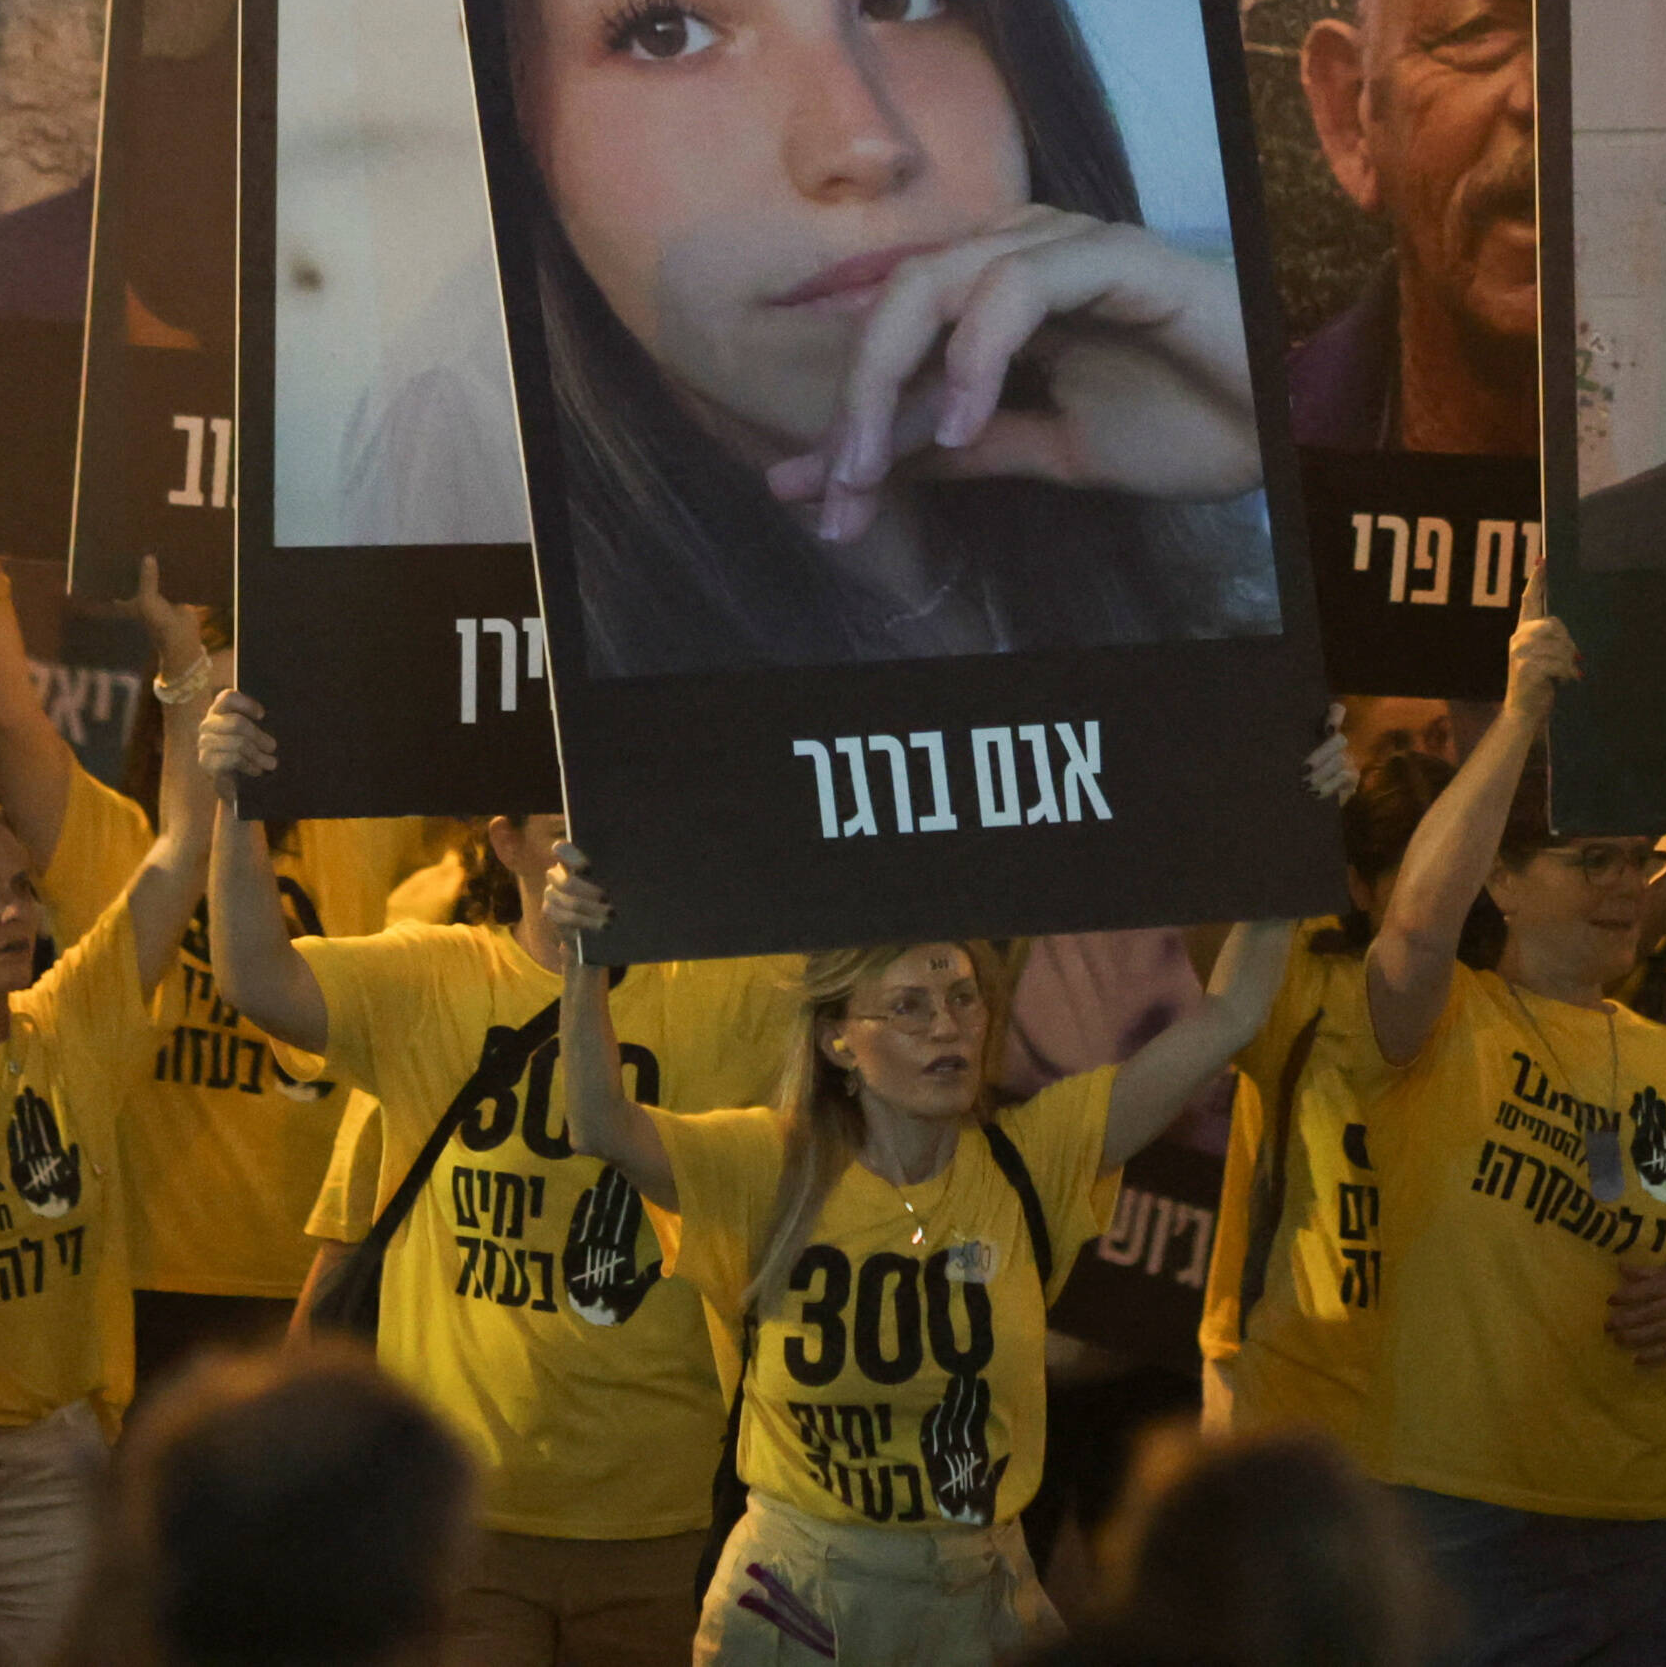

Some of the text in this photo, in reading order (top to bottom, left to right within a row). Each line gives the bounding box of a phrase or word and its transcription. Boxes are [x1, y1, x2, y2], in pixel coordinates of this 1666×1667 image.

[1352, 513, 1541, 608] ים פרי
[793, 721, 1113, 838] אגם ברגר
[55, 1225, 85, 1275] די
[453, 1166, 545, 1240] ימים
[1472, 1140, 1644, 1255] להפקרה!
[784, 1245, 995, 1386] 300
